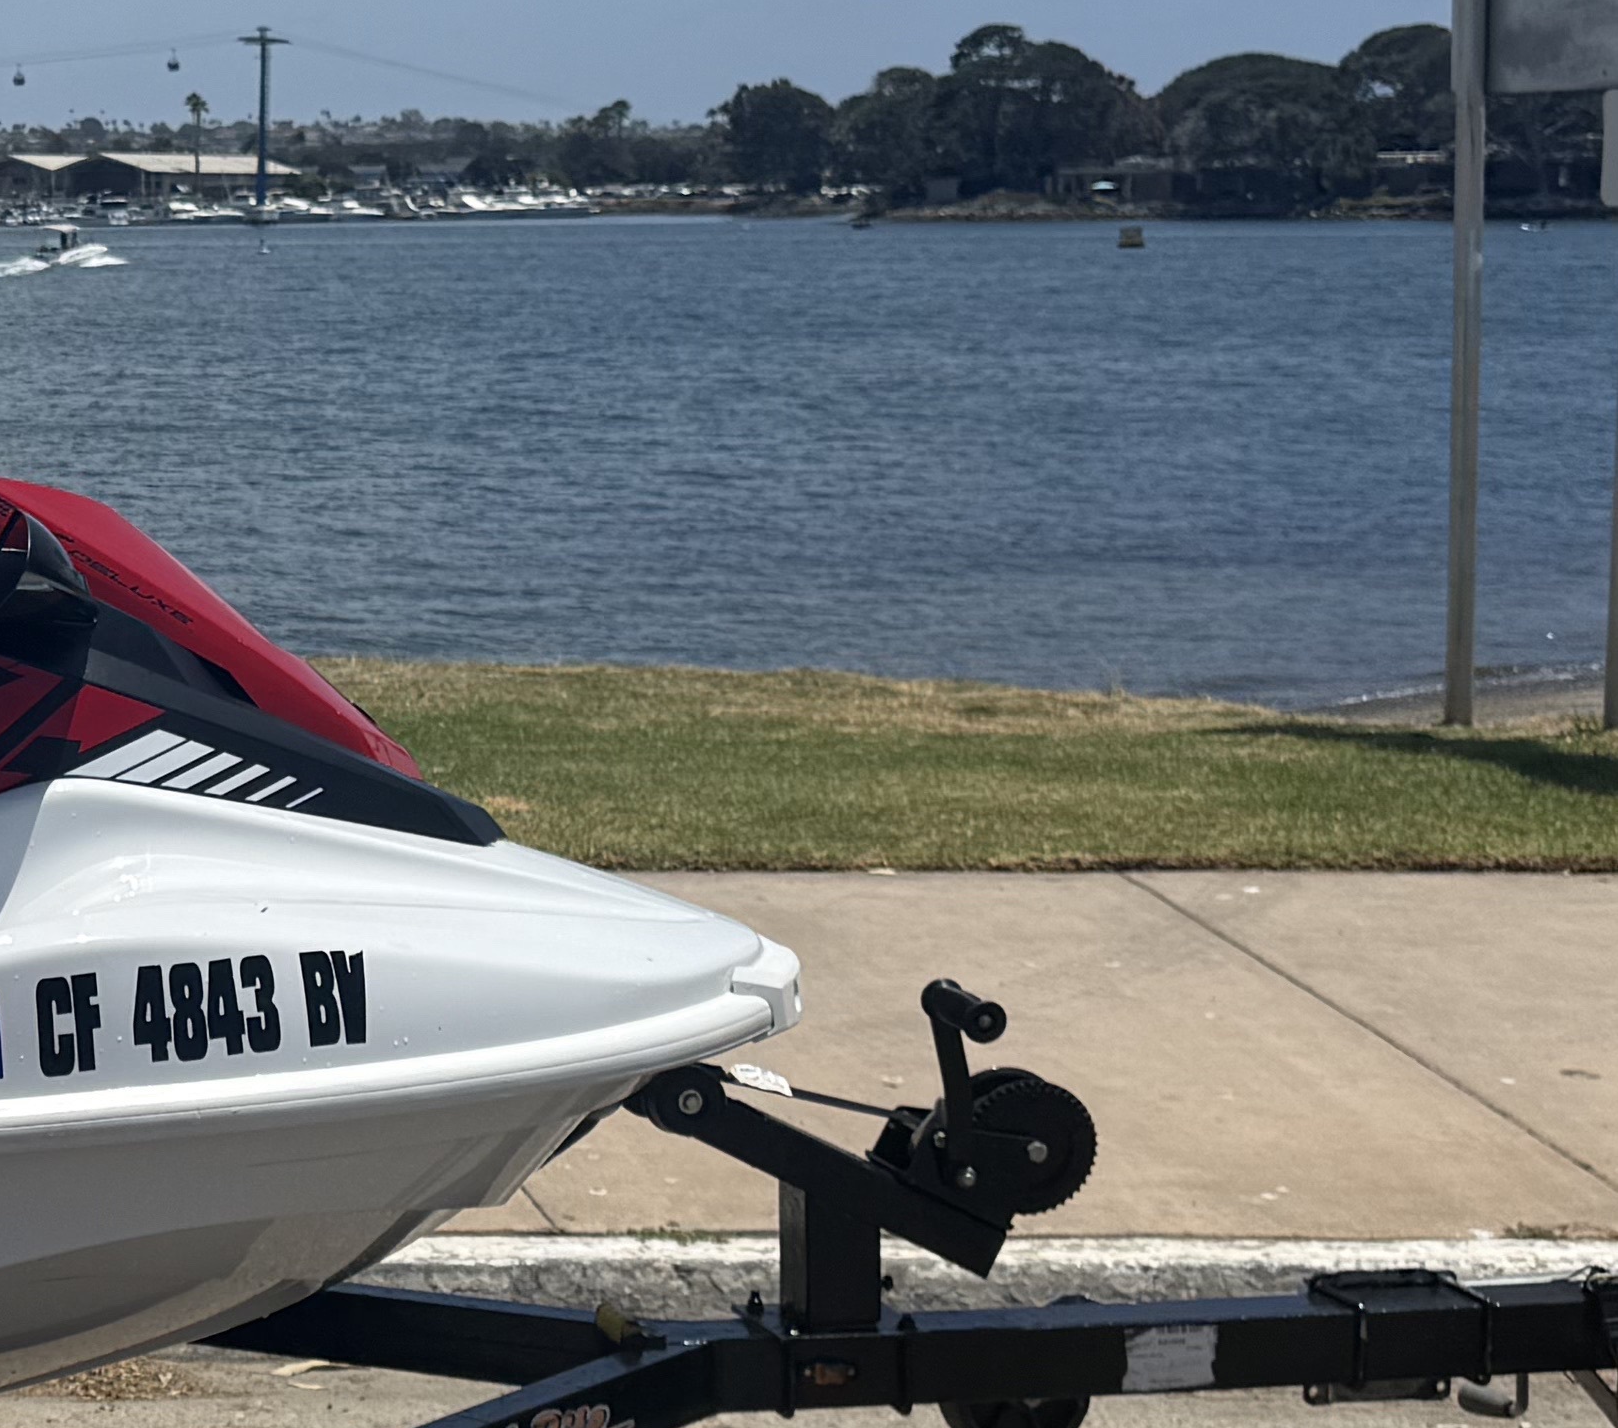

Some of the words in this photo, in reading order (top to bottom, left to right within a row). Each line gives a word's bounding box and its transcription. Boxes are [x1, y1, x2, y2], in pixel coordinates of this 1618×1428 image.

[36, 973, 101, 1077] CF
[133, 954, 281, 1062] 4843
[299, 950, 367, 1047] BV
